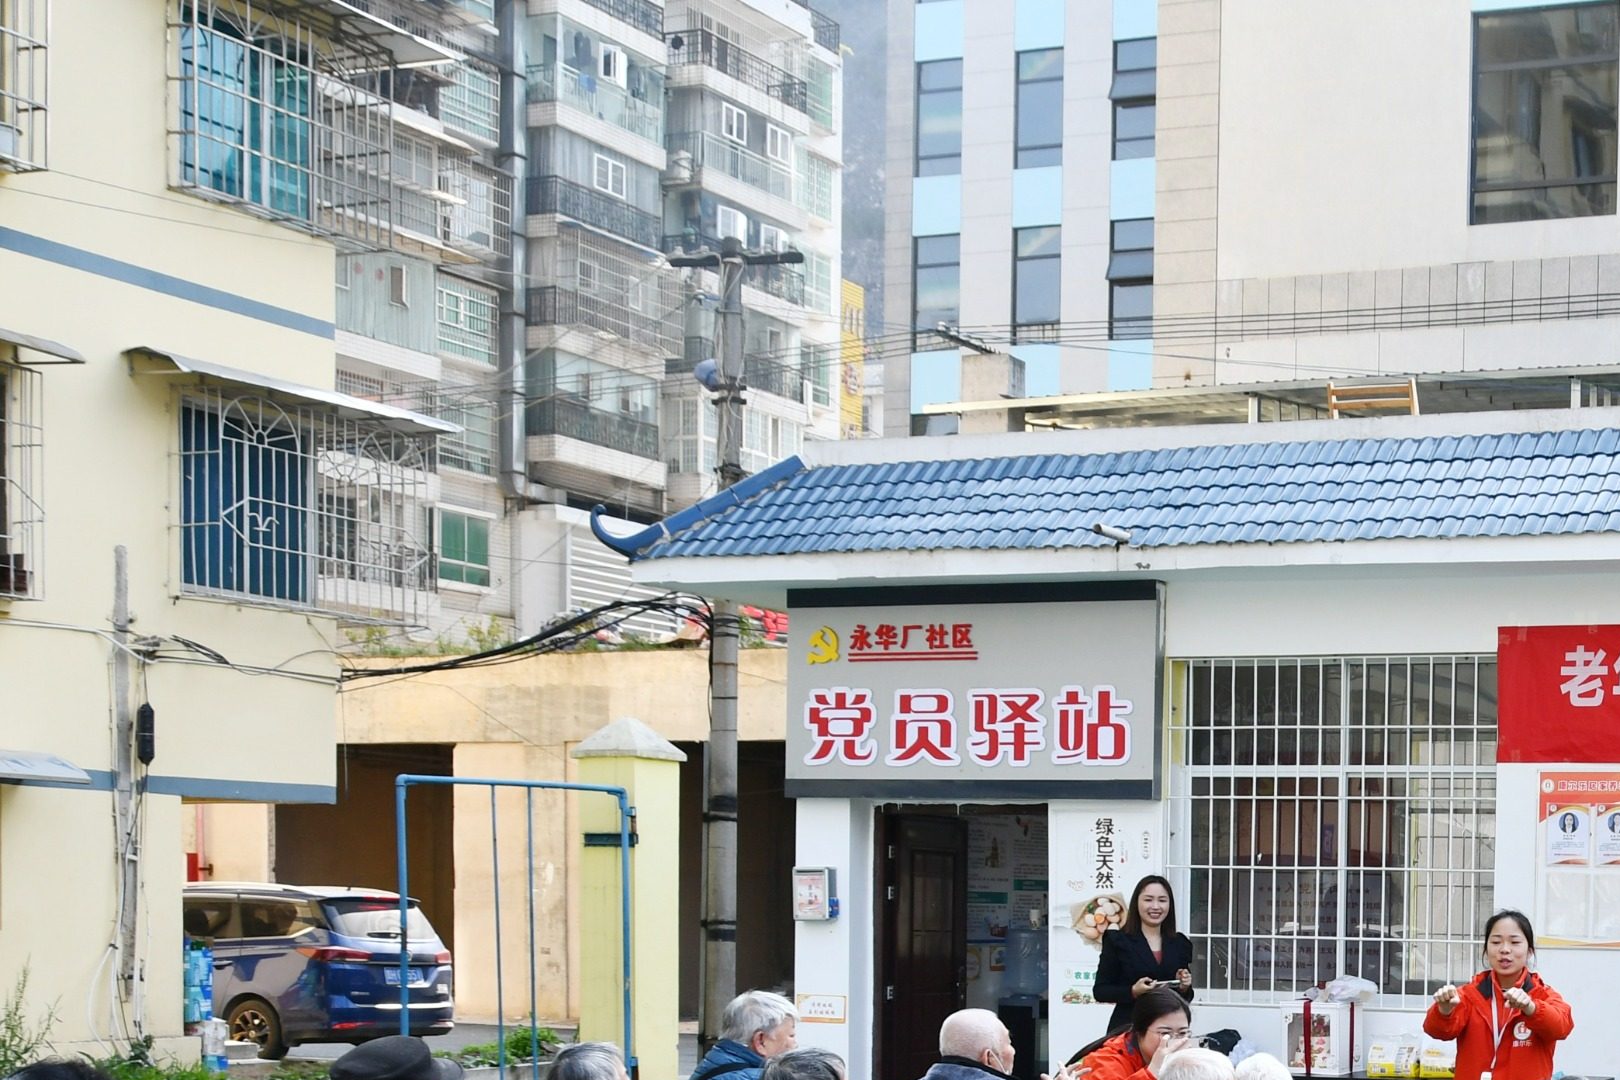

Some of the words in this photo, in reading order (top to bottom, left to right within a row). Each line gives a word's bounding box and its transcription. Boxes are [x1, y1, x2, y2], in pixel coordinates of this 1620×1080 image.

[849, 624, 974, 651] 永华厂社区
[808, 690, 1128, 762] 党员驿站
[1095, 818, 1115, 889] 绿色天然
